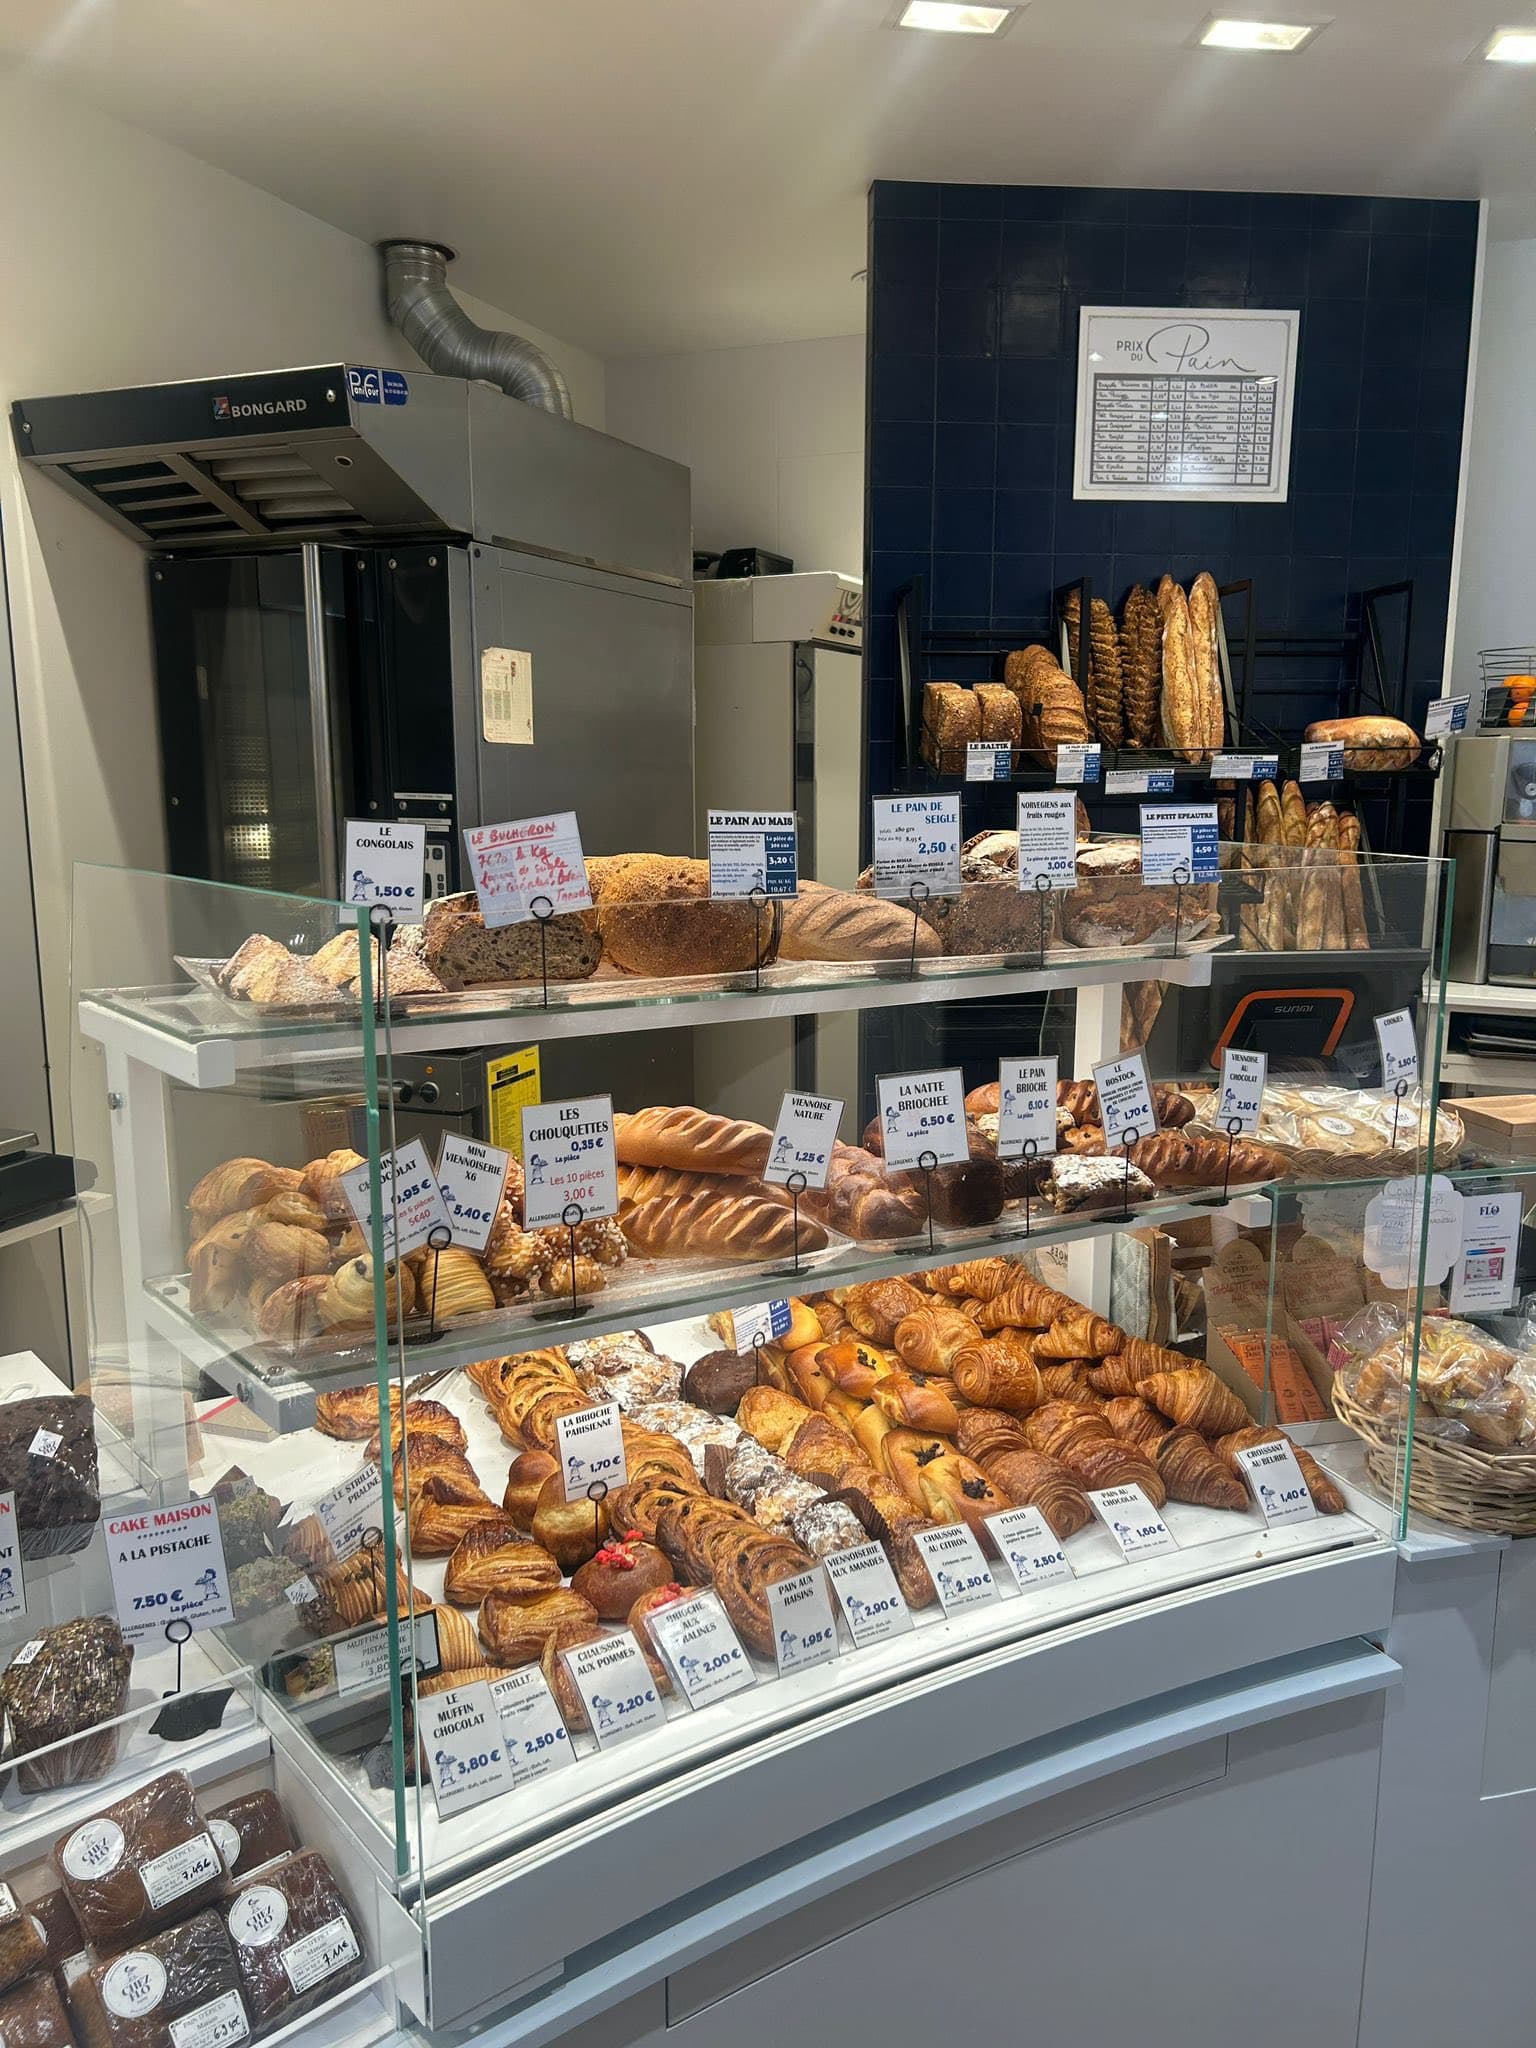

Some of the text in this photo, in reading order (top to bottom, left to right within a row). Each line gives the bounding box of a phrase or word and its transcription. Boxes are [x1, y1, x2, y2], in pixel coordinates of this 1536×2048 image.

[1116, 324, 1256, 372] PRIX Pain
[1131, 353, 1143, 361] DU
[232, 399, 307, 417] BONGARD
[891, 802, 942, 812] LE PAIN DE
[710, 817, 793, 825] LE PAIN AU MAIS
[925, 814, 957, 824] SEIGLE
[380, 827, 391, 836] LE
[472, 822, 555, 845] LE BUCHERON
[357, 839, 414, 849] CONGOLAIS
[919, 842, 957, 854] 2,50 €
[769, 857, 787, 865] 3,20
[375, 886, 415, 897] 1,50 €
[1384, 1015, 1403, 1026] COOKIES
[1232, 1054, 1259, 1063] VIENNOISE
[1019, 1068, 1045, 1078] LE PAIN
[1105, 1071, 1136, 1087] BOSTOCK
[1230, 1074, 1258, 1082] CHOCOLAT
[900, 1081, 944, 1096] LA NATTE
[1016, 1082, 1047, 1093] BRIOCHE
[792, 1097, 832, 1111] VIENNOISE
[898, 1095, 949, 1111] BRIOCHEE
[1237, 1101, 1251, 1110] 2,10
[560, 1108, 579, 1121] LES
[794, 1109, 824, 1120] NATURE
[1124, 1104, 1148, 1120] 1,70 €
[920, 1114, 955, 1127] 6.50 €
[529, 1121, 608, 1141] CHOUQUETTES
[467, 1145, 486, 1159] MINI
[571, 1138, 603, 1152] 0,35 €
[445, 1151, 502, 1176] VIENNOISERIE
[795, 1152, 824, 1163] 1,25 €
[421, 1178, 432, 1189] €
[465, 1170, 477, 1181] X6
[550, 1170, 605, 1186] Les 10 pièces
[563, 1186, 594, 1202] 3,00 €
[453, 1204, 491, 1223] 5,40 €
[1480, 1206, 1499, 1215] FLO
[563, 1407, 612, 1427] LA BRIOCHE
[565, 1418, 613, 1438] PARISIENNE
[1247, 1444, 1283, 1459] CROISSANT
[590, 1456, 621, 1472] 1,70 €
[1252, 1453, 1288, 1467] AU BEURRE
[333, 1467, 376, 1501] LE STRILLE
[347, 1477, 380, 1504] PRALINE
[1102, 1495, 1138, 1507] CHOCOLAT
[1280, 1488, 1307, 1502] 1,40 €
[109, 1503, 212, 1535] CAKE MAISON
[1000, 1512, 1026, 1524] PEPITO
[923, 1528, 962, 1543] CHAUSSON
[1157, 1524, 1165, 1532] €
[119, 1534, 212, 1562] A LA PISTACHE
[929, 1537, 967, 1553] AU CITRON
[827, 1544, 880, 1567] VIENNOISERIE
[1034, 1552, 1065, 1568] 2,50 €
[832, 1556, 885, 1578] AUX AMANDES
[778, 1575, 814, 1595] PAIN AUX
[956, 1574, 991, 1592] 2,50 €
[132, 1589, 184, 1611] 7.50 €
[784, 1588, 814, 1607] RAISINS
[889, 1597, 898, 1607] €
[170, 1600, 204, 1613] La pièce
[683, 1618, 700, 1630] AUX
[346, 1634, 379, 1650] MUFFIN
[802, 1627, 832, 1649] 1,95 €
[578, 1638, 625, 1662] CHAUSSON
[577, 1648, 636, 1676] AUX POMMES
[703, 1648, 741, 1673] 2,00 €
[446, 1693, 459, 1705] LE
[617, 1691, 655, 1714] 2,20 €
[438, 1703, 474, 1722] MUFFIN
[433, 1713, 485, 1738] CHOCOLAT
[525, 1728, 566, 1754] 2,50 €
[458, 1749, 501, 1774] 3,80 €
[253, 1915, 273, 1932] FLO
[122, 1974, 151, 1996] CHEZ
[129, 1984, 150, 2002] FLO
